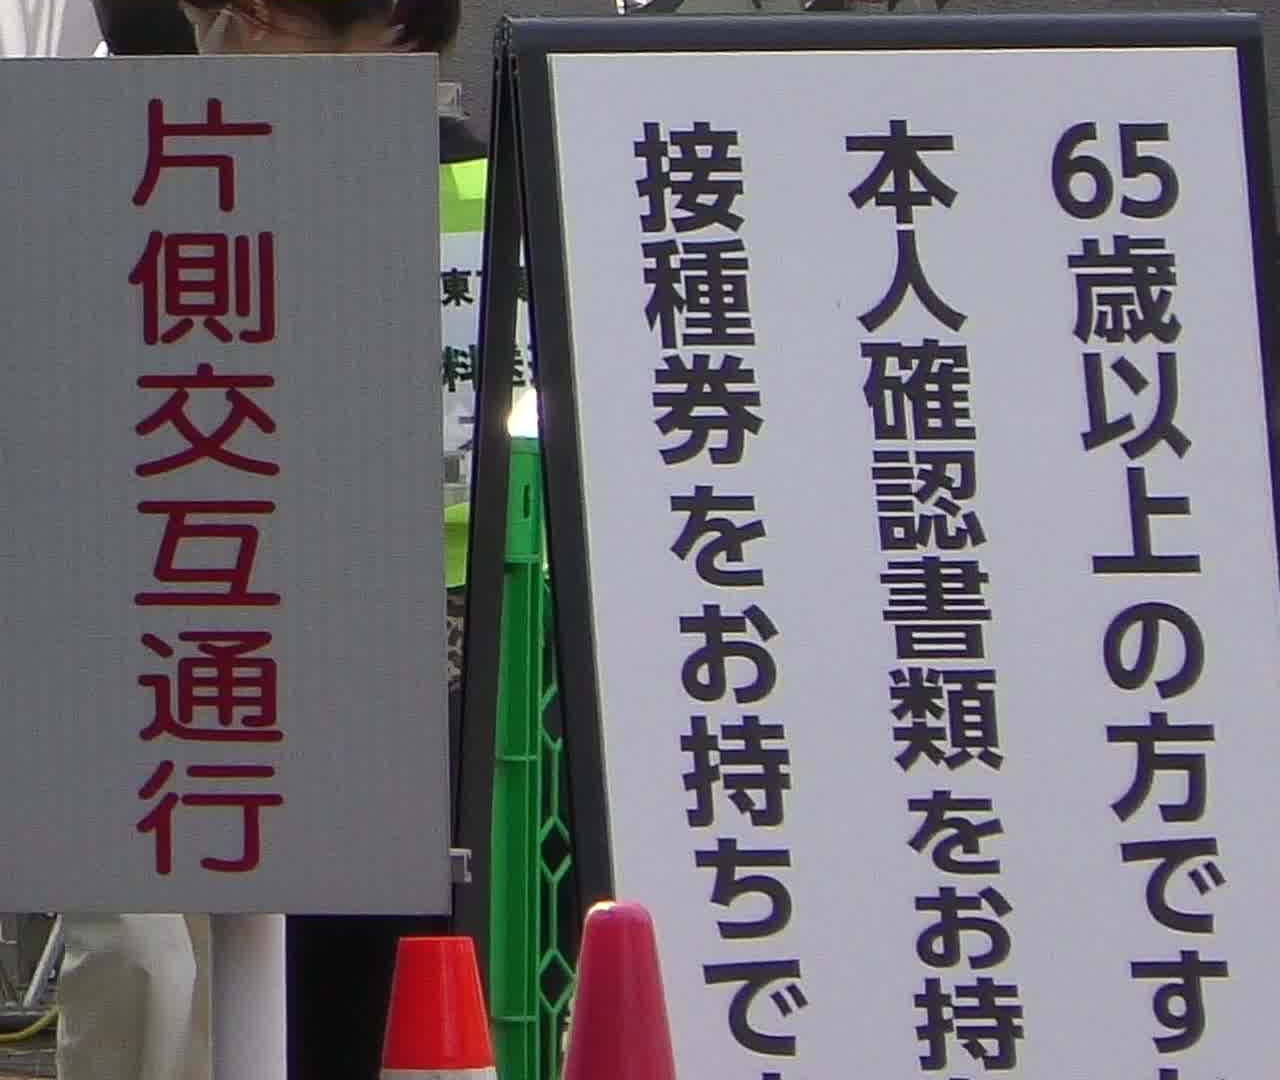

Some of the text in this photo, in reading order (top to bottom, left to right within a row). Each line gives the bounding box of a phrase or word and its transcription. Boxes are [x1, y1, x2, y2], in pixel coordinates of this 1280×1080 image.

[127, 97, 284, 875] 片側交互通行
[633, 121, 809, 1080] 接種券をお持ちで
[845, 119, 1026, 1080] 本人確認書類をお持
[1051, 120, 1230, 1080] 65歳以上の方です
